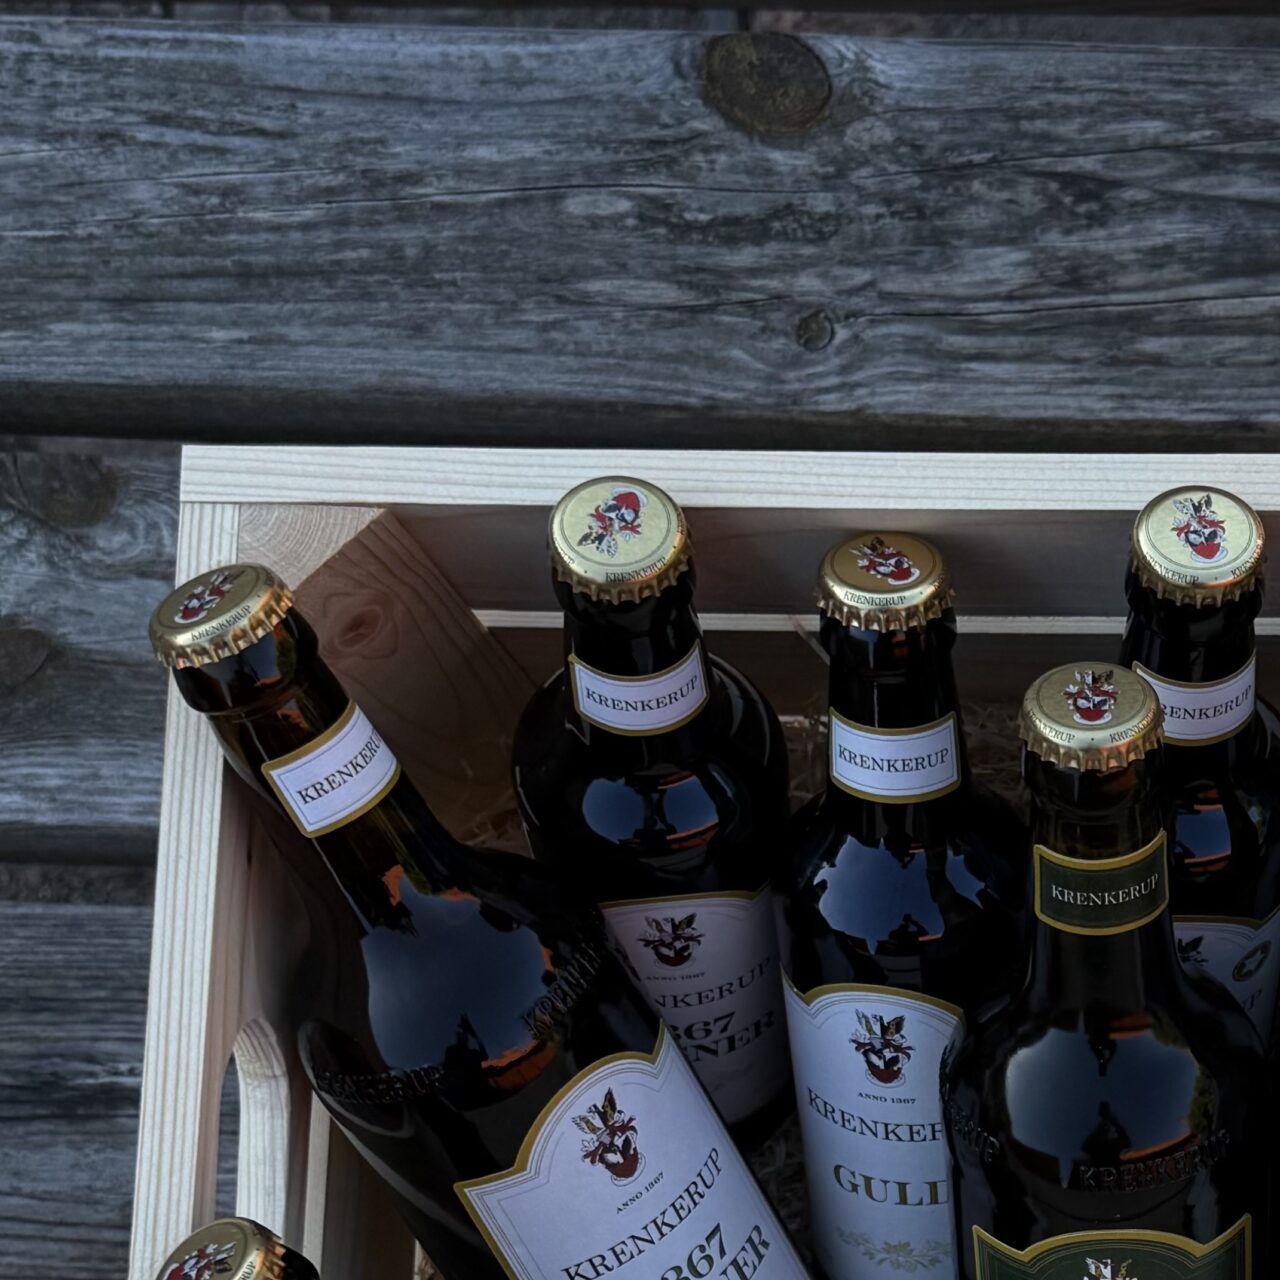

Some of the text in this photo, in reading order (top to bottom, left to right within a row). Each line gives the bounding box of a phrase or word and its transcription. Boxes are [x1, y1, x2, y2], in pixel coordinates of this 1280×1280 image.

[843, 590, 907, 609] KRENKERUP
[191, 604, 252, 643] KRENKERUP
[585, 674, 699, 713] KRENKERUP
[838, 743, 950, 774] KRENKERUP
[1050, 873, 1160, 907] KRENKERUP
[654, 956, 771, 1009] NKERUP
[669, 1010, 736, 1042] 367
